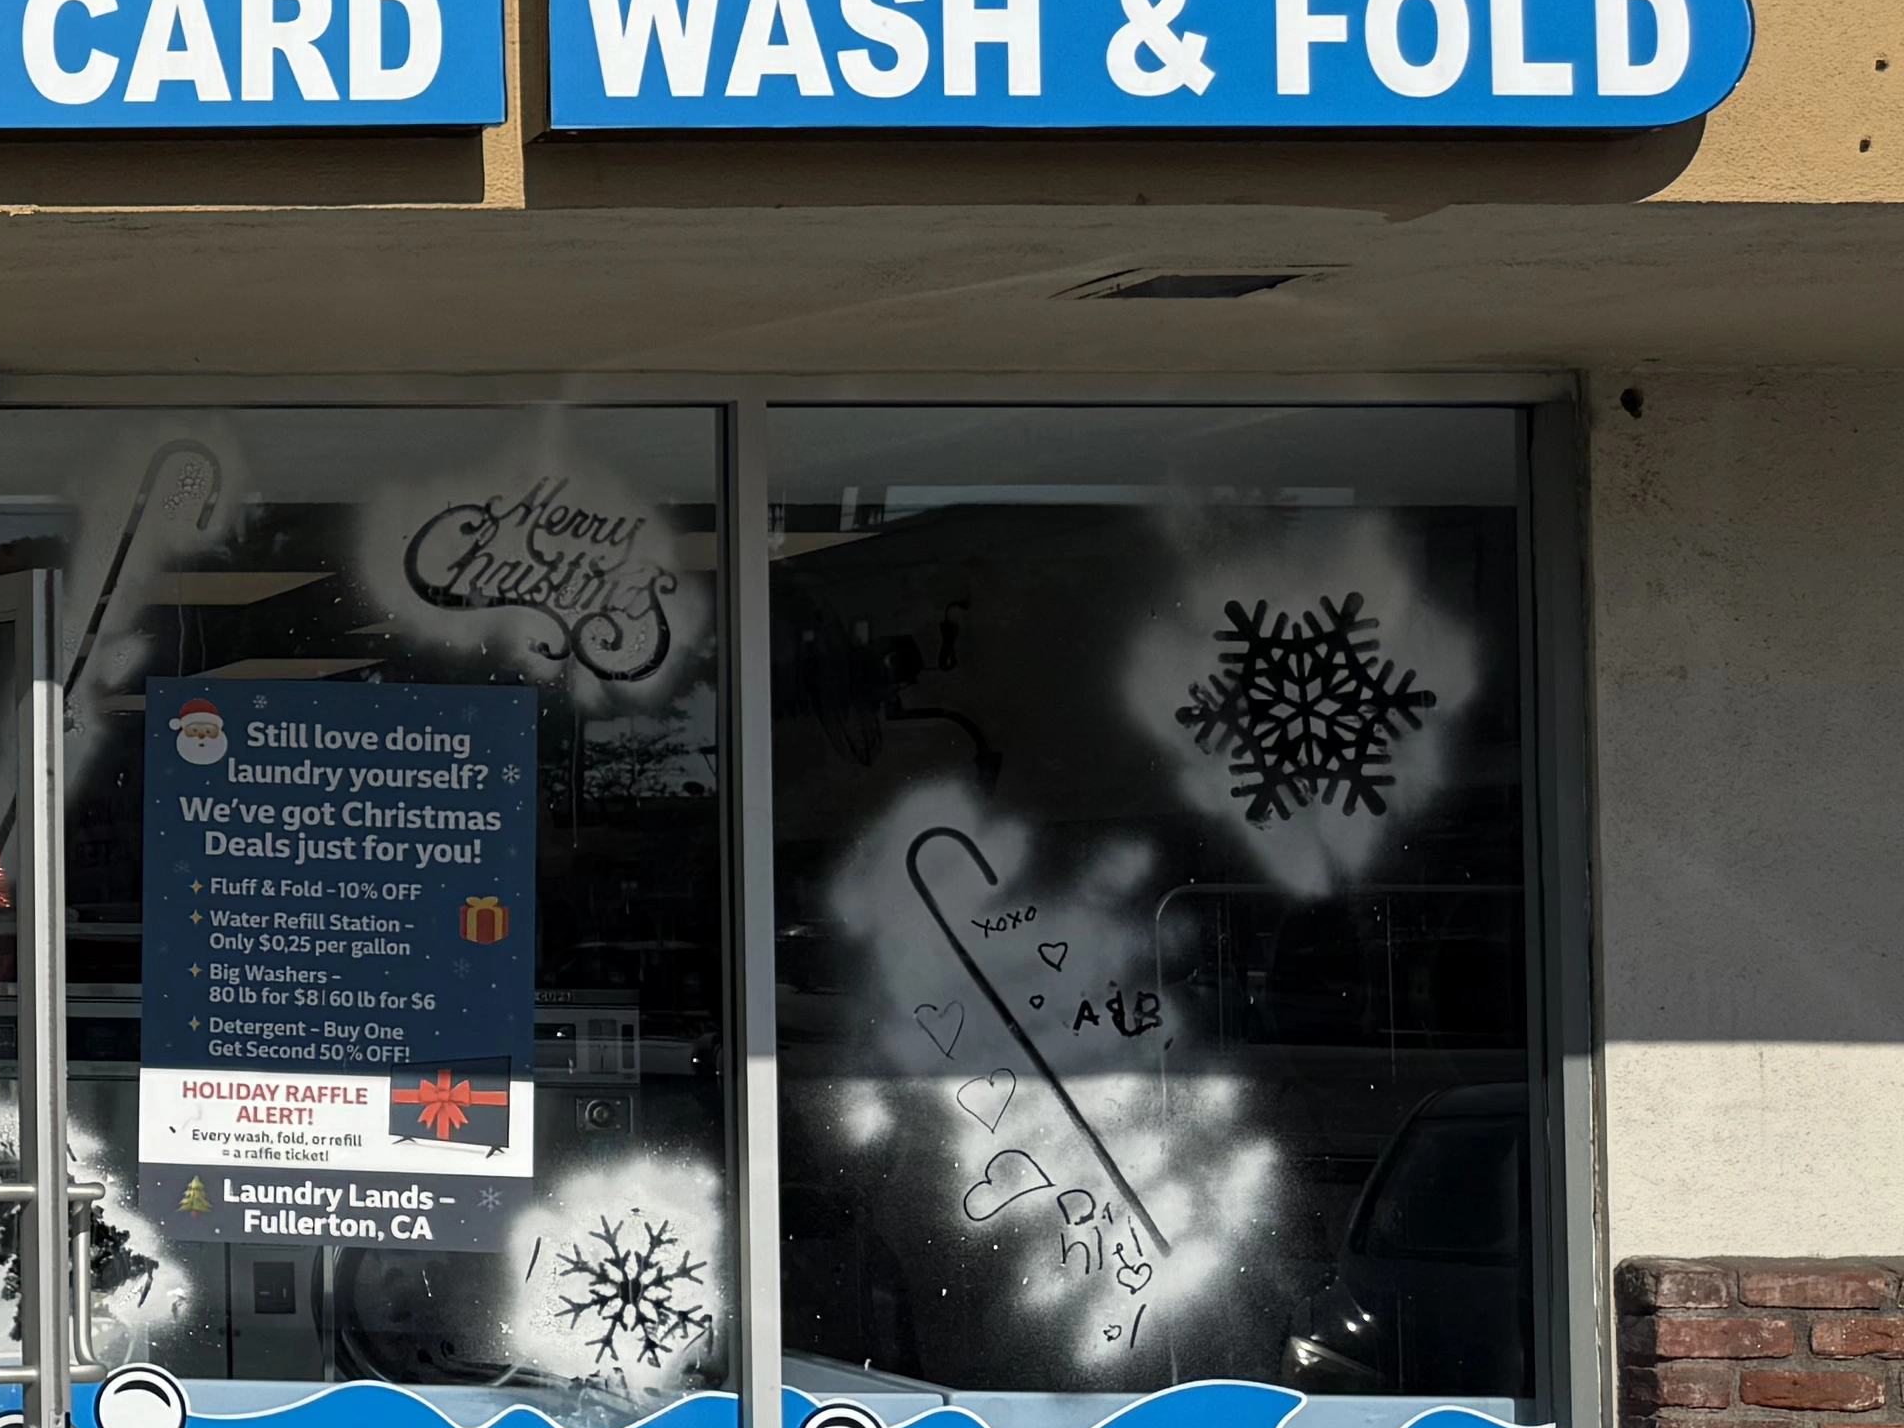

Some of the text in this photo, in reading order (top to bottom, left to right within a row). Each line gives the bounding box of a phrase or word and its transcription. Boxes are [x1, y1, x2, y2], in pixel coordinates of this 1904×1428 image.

[488, 476, 646, 558] Merry
[247, 722, 471, 759] Still love doing
[227, 757, 488, 793] laundry yourself?
[180, 797, 501, 831] We’ve got Christmas
[205, 831, 481, 869] Deals just for you!
[210, 878, 257, 896] Fluff
[261, 880, 276, 897] &
[281, 880, 323, 898] Fold
[383, 883, 422, 901] OFF
[210, 910, 400, 932] Water Refill Station
[210, 933, 253, 954] Only
[315, 938, 346, 956] per
[351, 938, 410, 958] gallon
[210, 964, 327, 984] Big Washers
[209, 987, 235, 1003] 80
[239, 987, 257, 1004] lb
[262, 988, 289, 1005] for
[329, 990, 353, 1007] 60
[358, 991, 375, 1008] lb
[380, 992, 407, 1009] for
[411, 992, 435, 1010] $6
[209, 1017, 404, 1041] Detergent Buy One
[208, 1039, 242, 1057] Get
[246, 1041, 315, 1059] Second
[366, 1045, 410, 1063] OFF!
[182, 1081, 368, 1105] HOLIDAY RAFFLE
[236, 1106, 314, 1125] ALERT!
[192, 1129, 231, 1143] Every
[234, 1131, 273, 1144] wash,
[311, 1134, 326, 1145] or
[329, 1133, 362, 1147] refill
[223, 1179, 433, 1212] Laundry Lands
[243, 1209, 433, 1242] Fullerton, CA
